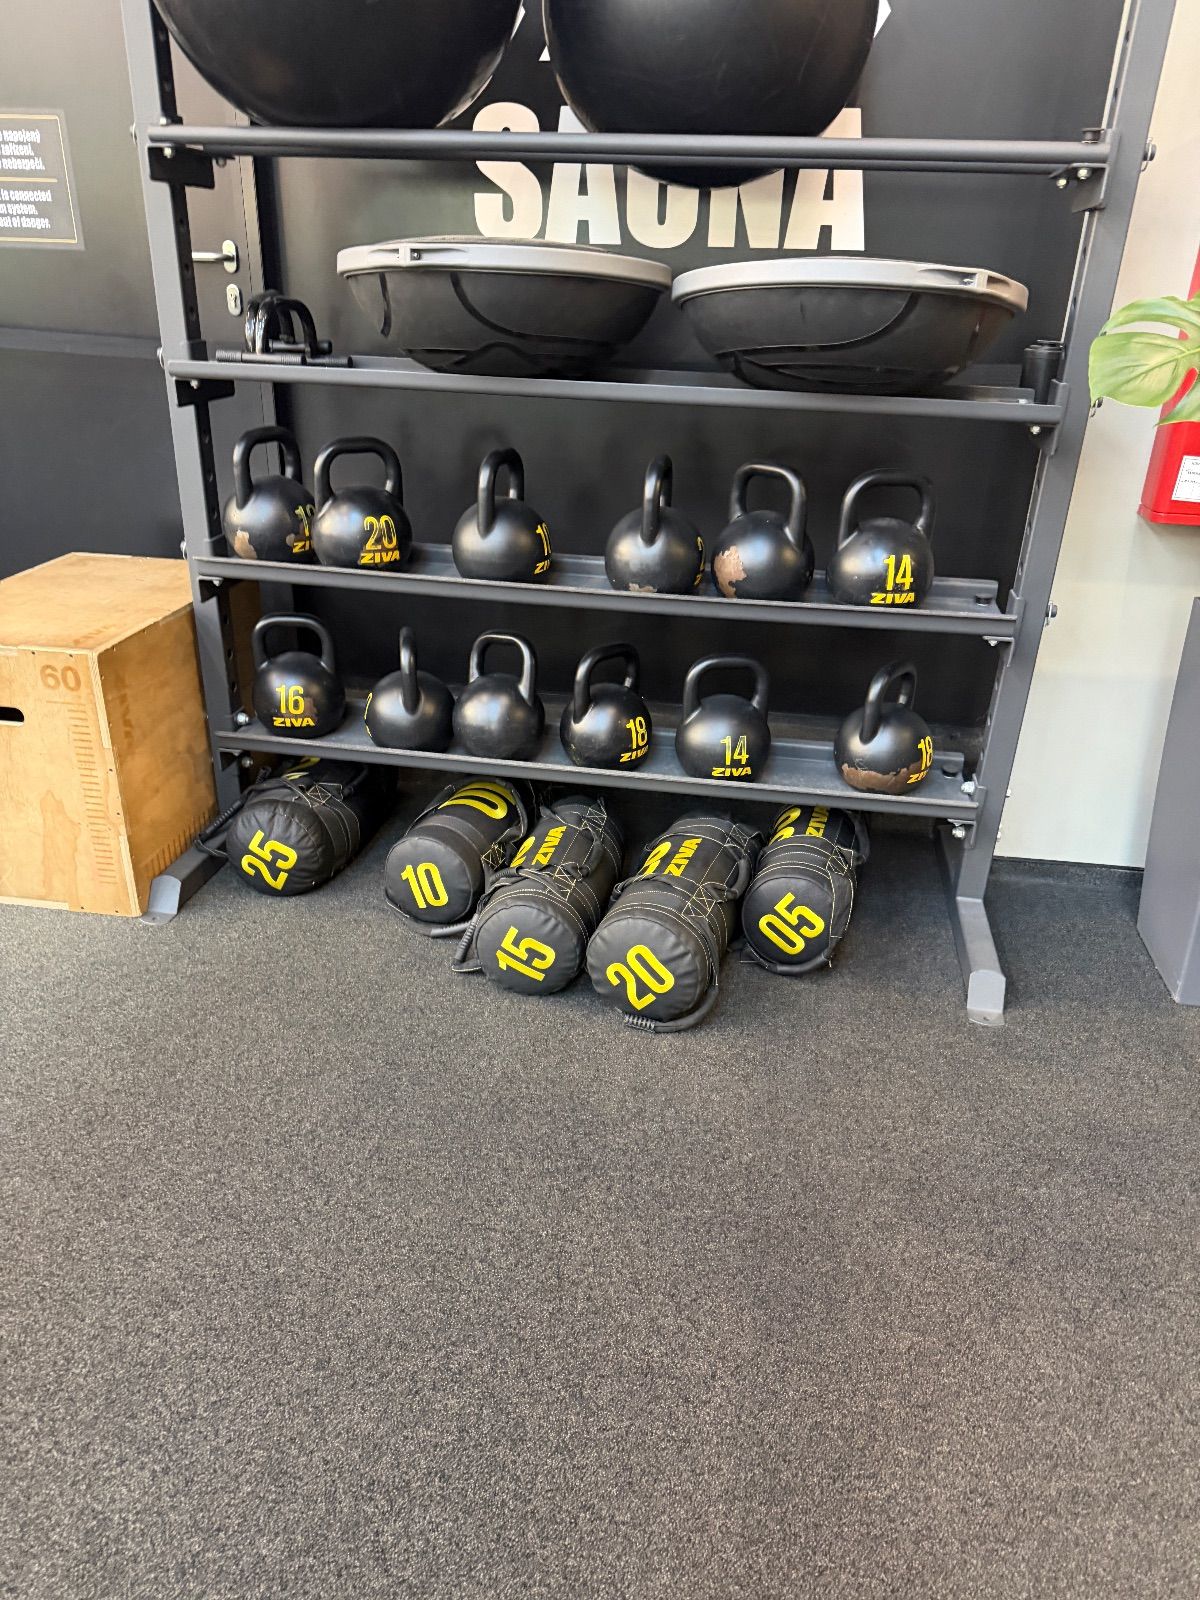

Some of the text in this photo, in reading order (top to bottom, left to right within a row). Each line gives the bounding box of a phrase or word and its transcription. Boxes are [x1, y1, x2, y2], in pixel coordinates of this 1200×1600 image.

[364, 514, 398, 551] 20
[359, 551, 401, 566] ZIVA
[884, 554, 914, 591] 14
[870, 591, 916, 605] ZIVA
[40, 664, 82, 692] 60
[275, 685, 305, 715] 16
[273, 716, 316, 728] ZIVA
[625, 716, 648, 750] 18
[720, 735, 750, 766] 14
[917, 735, 933, 770] 18
[711, 766, 752, 777] ZIVA
[241, 829, 298, 891] 25
[530, 825, 567, 866] ZIVA
[663, 837, 703, 878] ZIVA
[401, 862, 448, 909] 10
[758, 891, 826, 956] 05
[496, 925, 557, 982] 15
[605, 943, 675, 1011] 20
